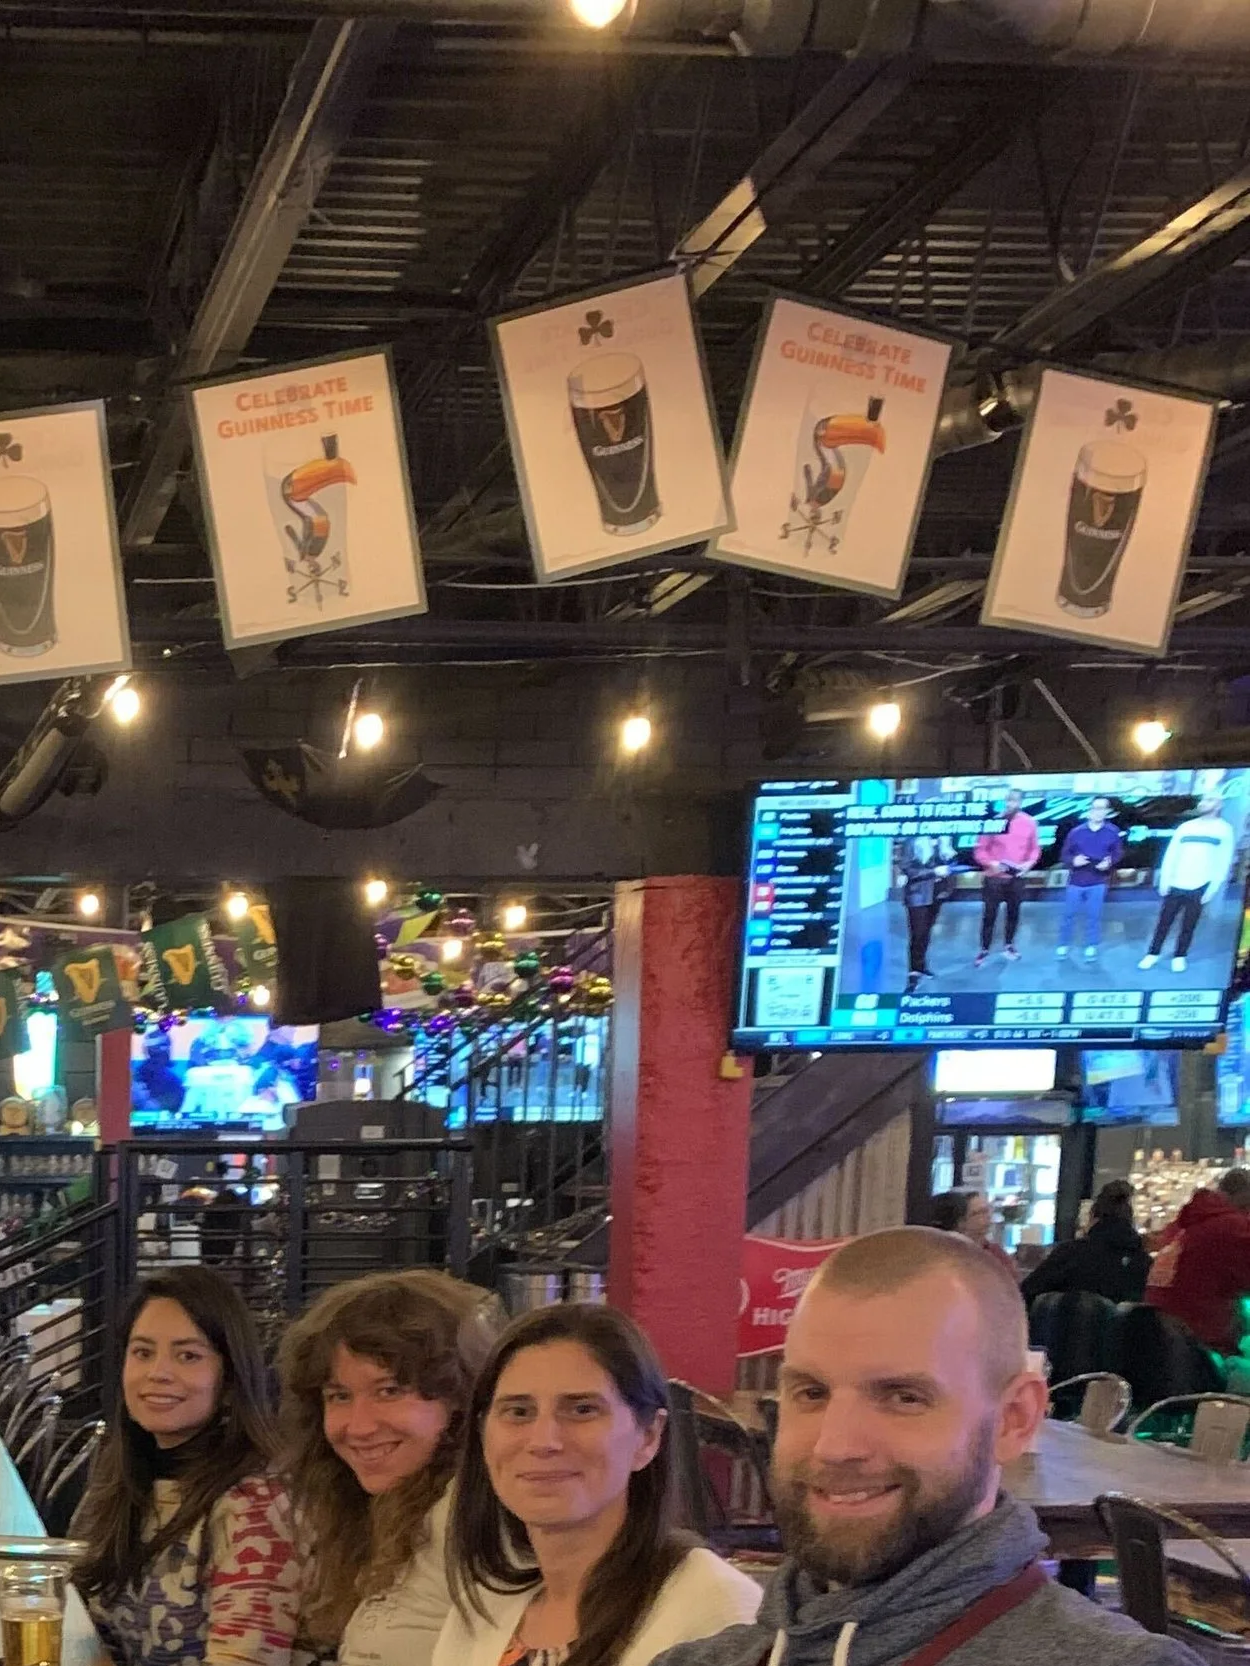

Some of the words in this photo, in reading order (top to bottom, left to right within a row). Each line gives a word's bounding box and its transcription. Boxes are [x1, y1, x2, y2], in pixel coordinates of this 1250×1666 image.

[807, 322, 912, 365] CELEBRATE
[780, 340, 877, 381] GUINNESS
[883, 365, 927, 394] TIME
[235, 377, 347, 411] CELEBRATE
[217, 408, 320, 439] GUINNESS
[323, 396, 374, 420] TIME
[900, 1012, 954, 1025] Dolphins
[752, 1307, 793, 1326] HIG
